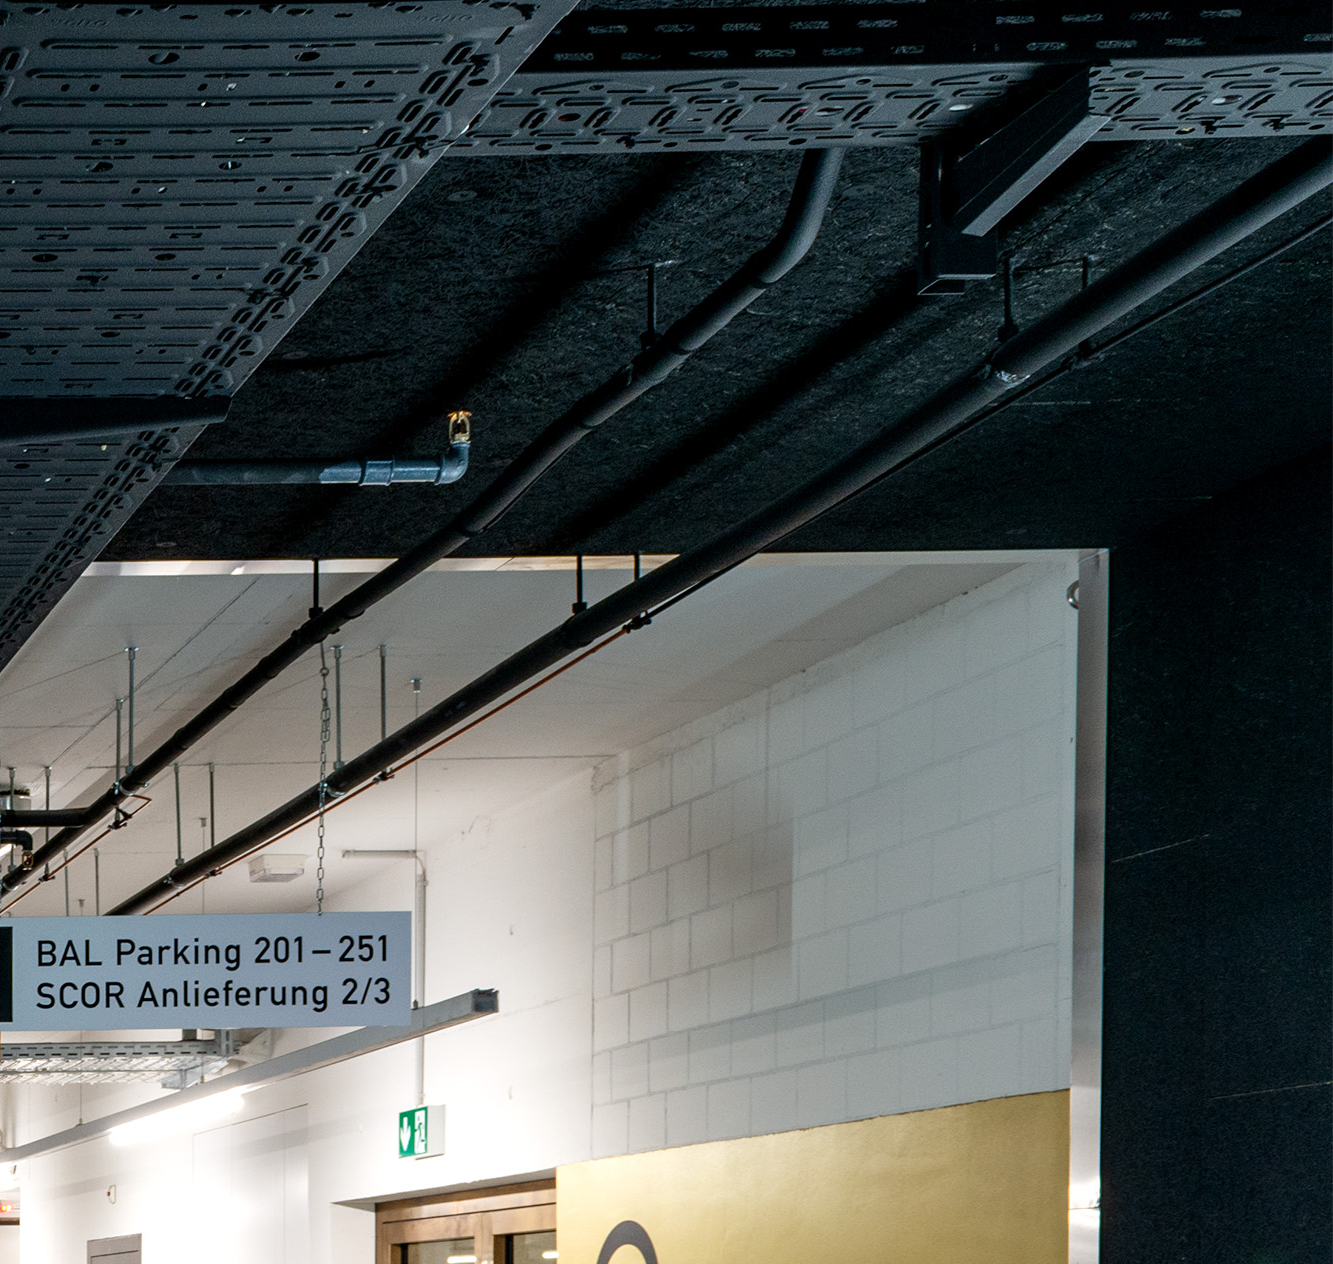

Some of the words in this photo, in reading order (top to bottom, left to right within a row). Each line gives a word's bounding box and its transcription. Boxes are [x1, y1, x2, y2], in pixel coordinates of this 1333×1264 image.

[38, 940, 102, 966] BAL
[117, 938, 240, 971] Parking
[37, 982, 124, 1009] SCOR
[137, 980, 327, 1012] Anlieferung
[342, 978, 389, 1004] 2/3
